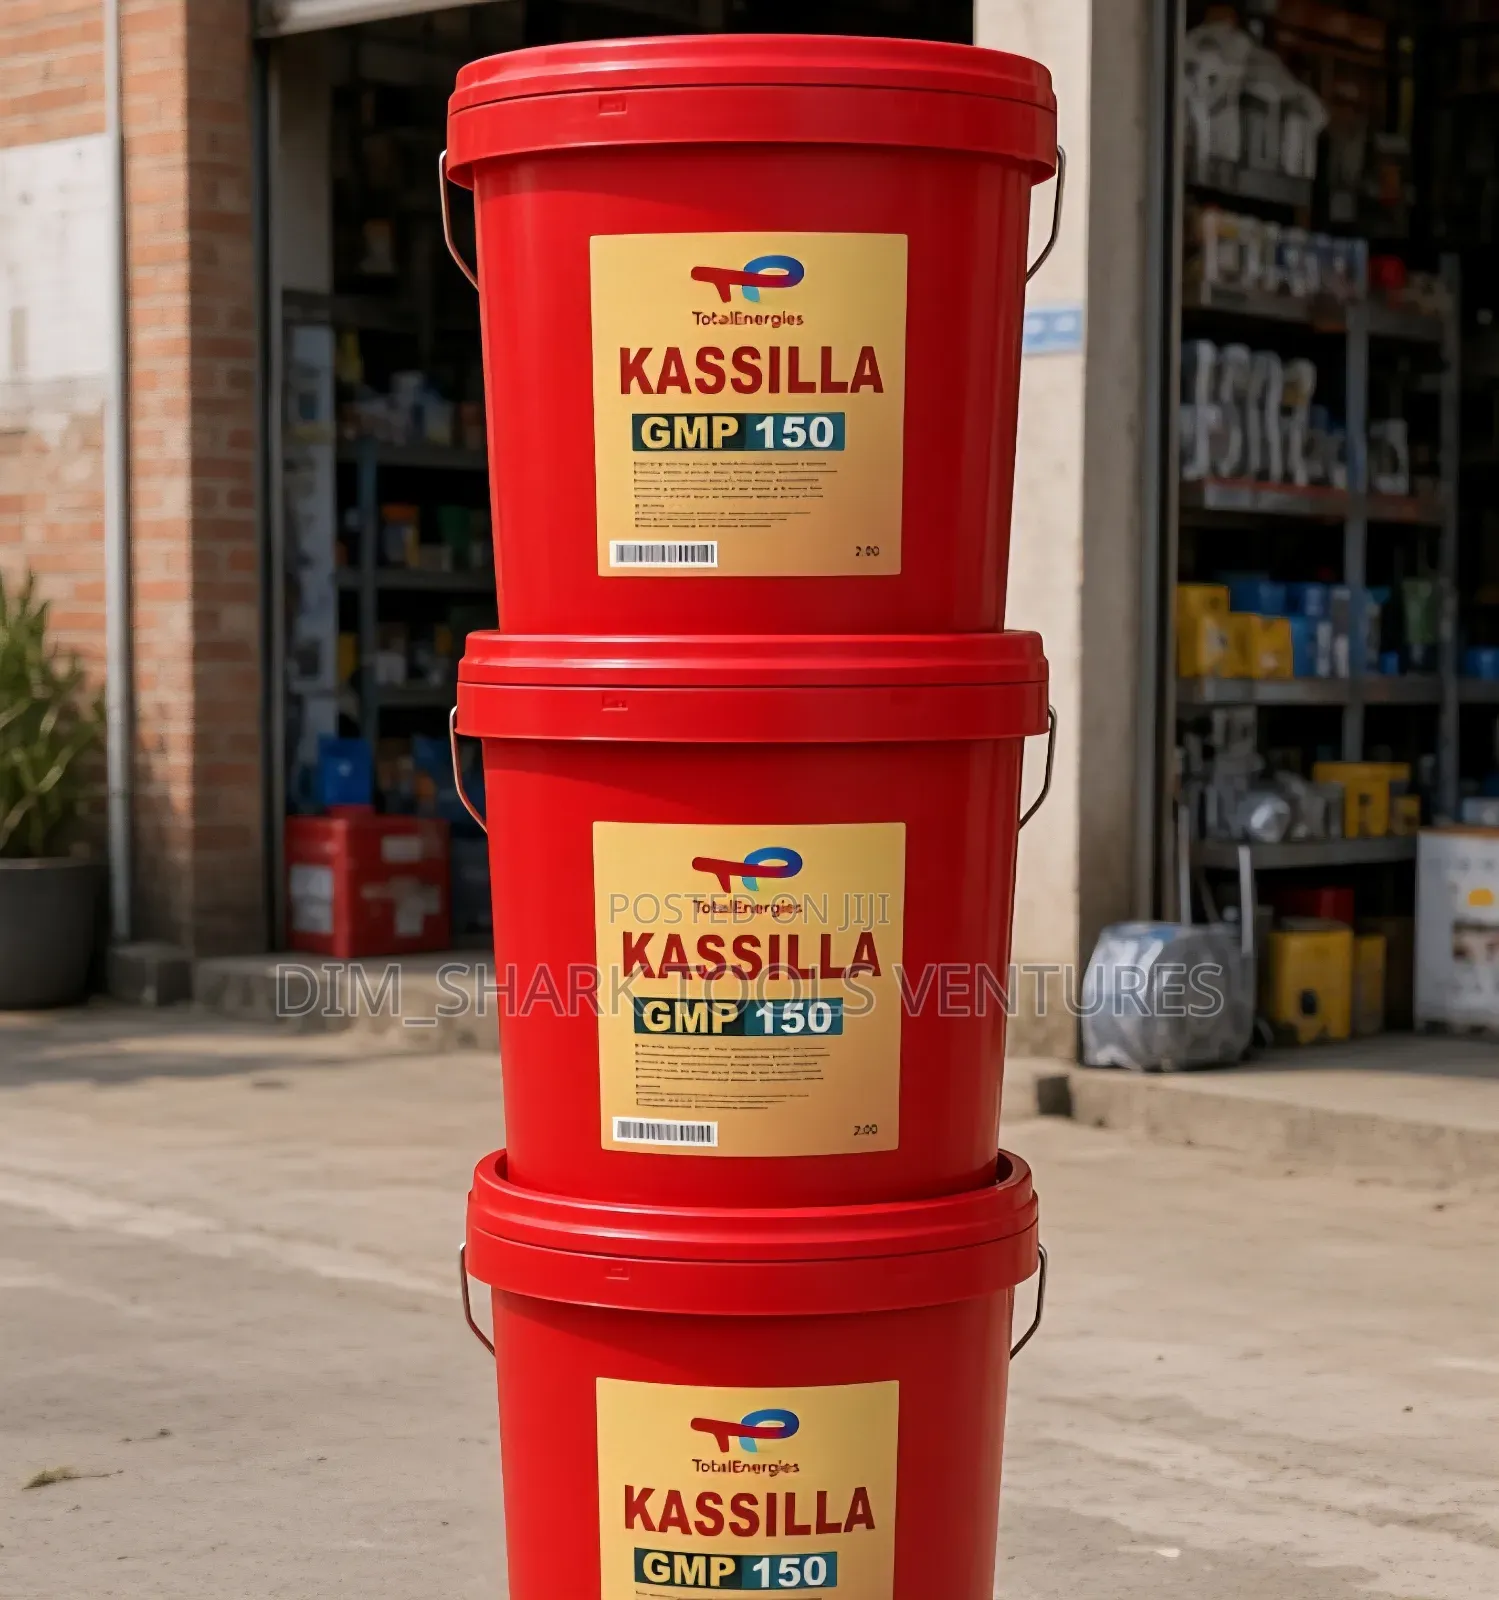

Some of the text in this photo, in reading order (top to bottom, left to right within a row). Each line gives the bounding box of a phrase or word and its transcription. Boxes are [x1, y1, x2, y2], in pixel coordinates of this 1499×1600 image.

[619, 346, 884, 395] KASSILLA
[640, 416, 834, 450] GMP 150
[622, 931, 882, 981] KASSILLA
[642, 1001, 833, 1035] GMP 150
[624, 1484, 876, 1538] KASSILLA
[642, 1552, 827, 1588] GMP 150
